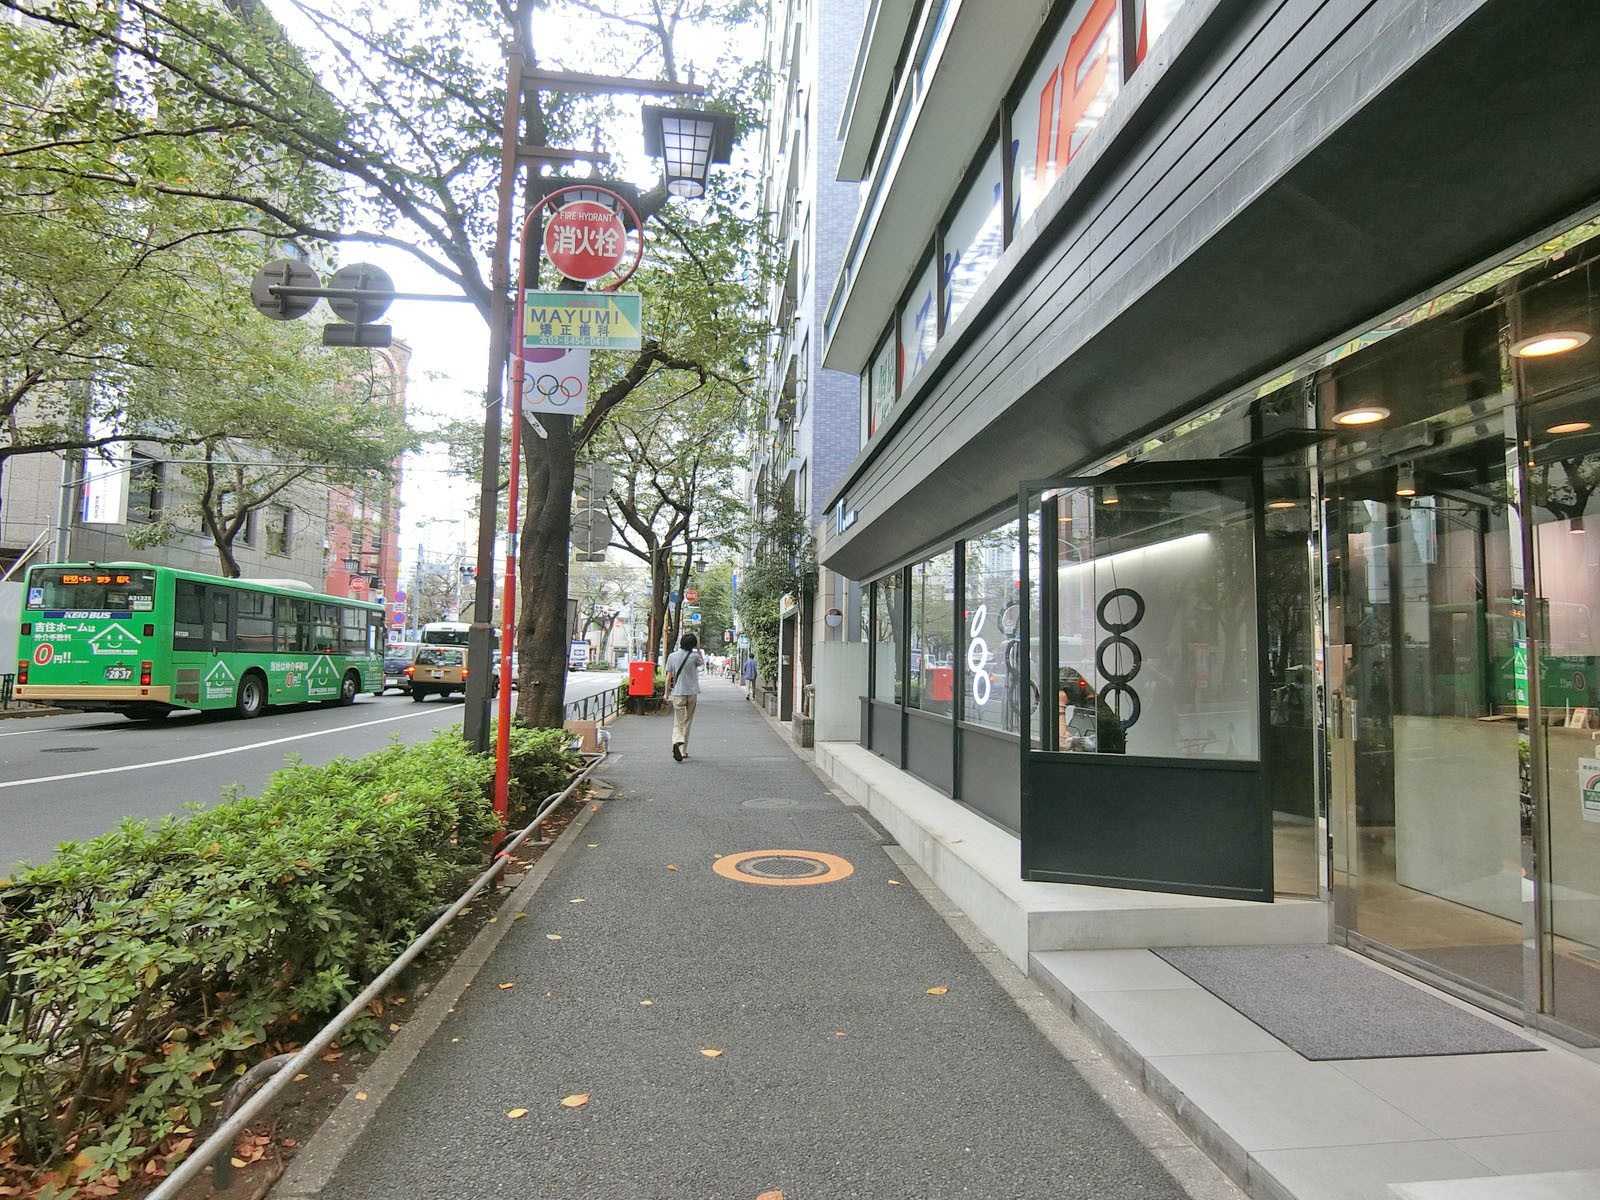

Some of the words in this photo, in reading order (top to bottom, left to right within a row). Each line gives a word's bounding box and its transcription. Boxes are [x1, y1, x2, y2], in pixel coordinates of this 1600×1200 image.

[560, 211, 577, 220] FIRE
[578, 212, 613, 223] HYDRANT
[552, 224, 620, 257] 消火栓
[531, 308, 619, 324] MAYUMI
[540, 323, 609, 336] 矯正歯科
[64, 611, 89, 619] KEIO
